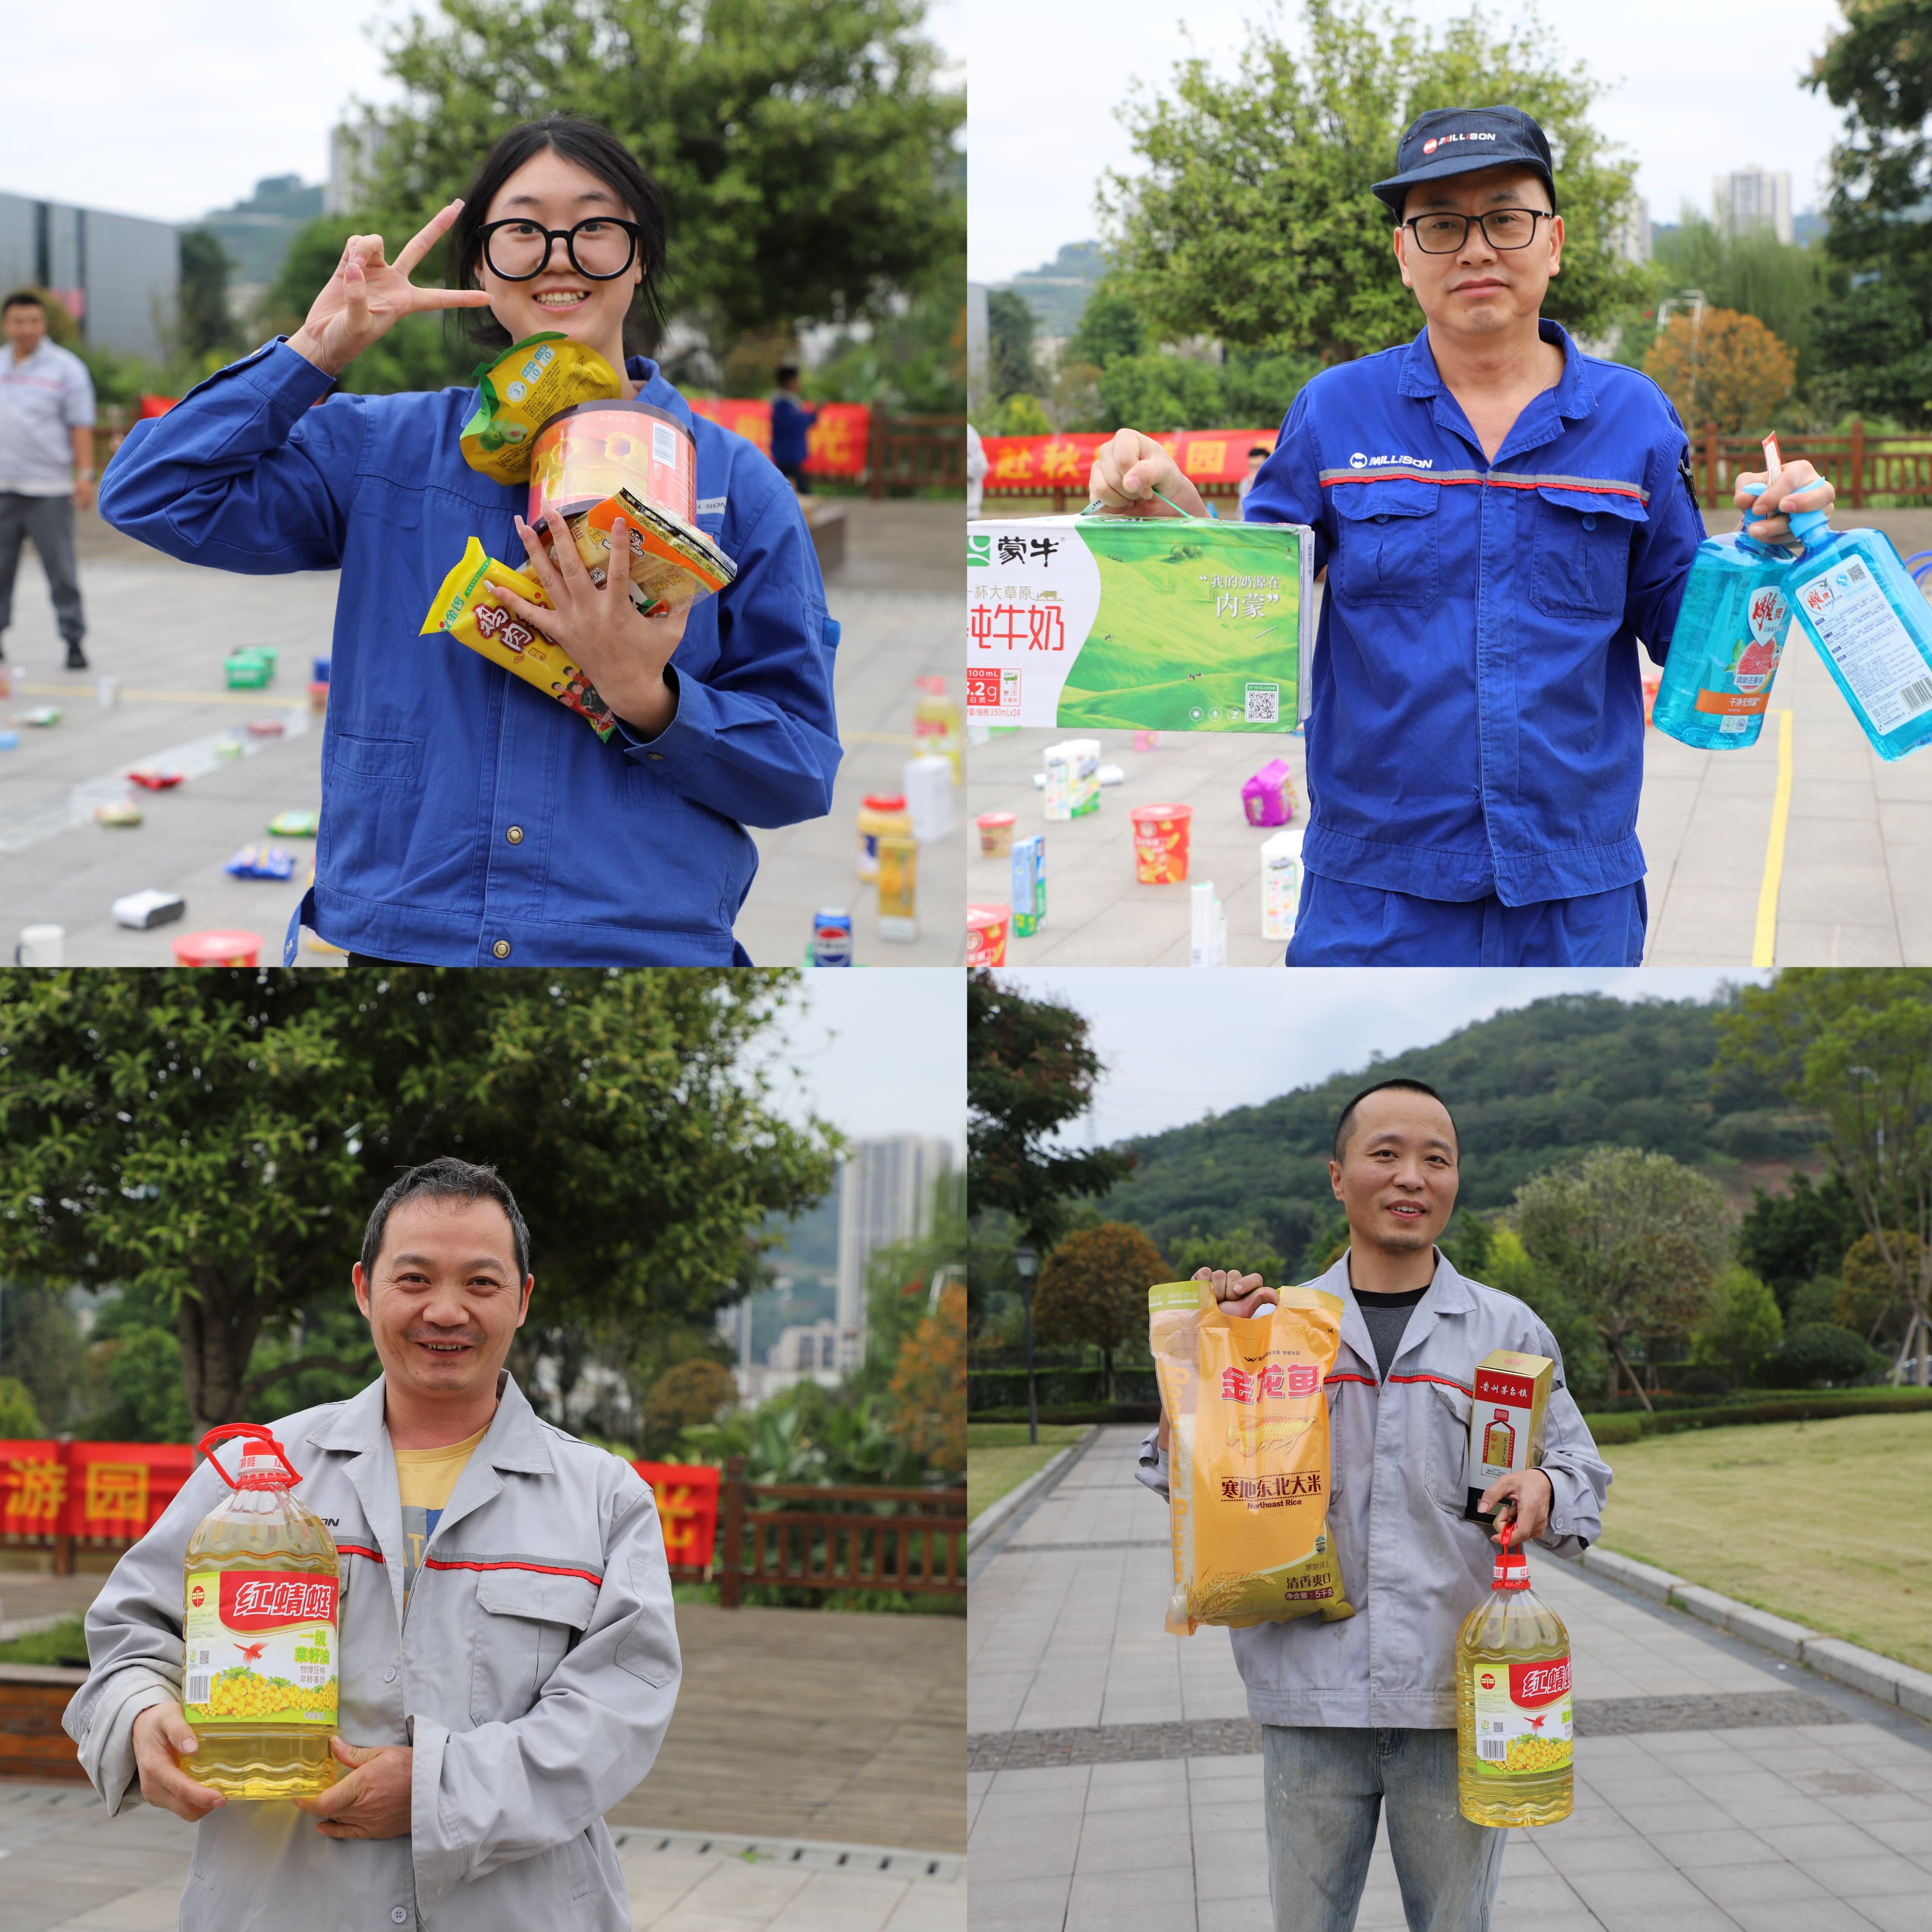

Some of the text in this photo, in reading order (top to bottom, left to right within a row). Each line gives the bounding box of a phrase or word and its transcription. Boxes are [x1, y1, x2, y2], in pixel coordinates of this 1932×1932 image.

[1438, 133, 1496, 146] MILLISON
[1368, 455, 1433, 468] MILLISON
[624, 505, 635, 516] ONE
[639, 517, 651, 528] ONE
[659, 530, 670, 542] ONE
[673, 541, 684, 551] ONE
[692, 554, 703, 565] ONE
[706, 564, 716, 575] ONE
[998, 536, 1059, 567] 蒙牛
[967, 708, 1020, 716] 量/规格:250mLx24
[1221, 1363, 1321, 1405] 金龙鱼
[1480, 1381, 1528, 1398] 贵州茅台镇
[240, 1456, 256, 1469] 蜻蜓
[1221, 1474, 1321, 1499] 寒地东北大米
[1247, 1501, 1283, 1509] Northeast
[1286, 1573, 1331, 1589] 清香爽口
[233, 1581, 331, 1619] 红蜻蜓
[299, 1629, 327, 1647] 一级
[294, 1646, 330, 1665] 菜籽油
[300, 1665, 325, 1674] 物理压榨
[300, 1675, 325, 1684] 非转基因
